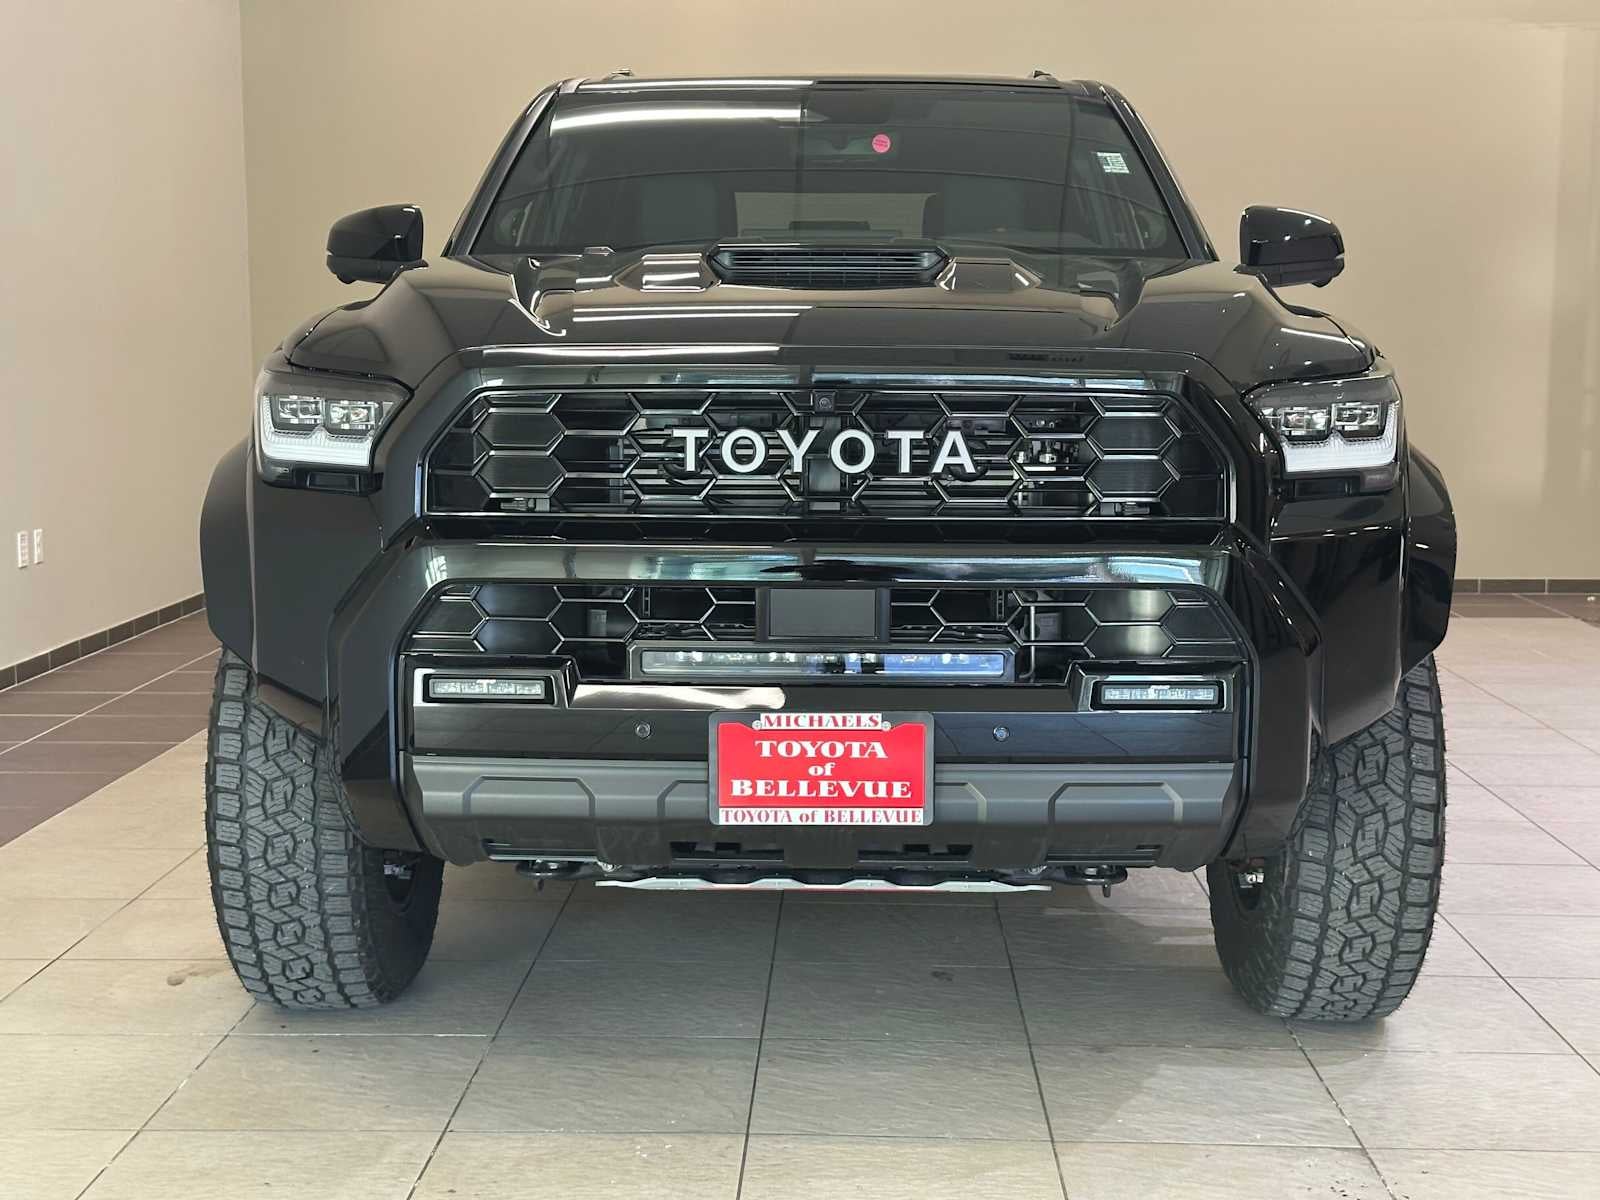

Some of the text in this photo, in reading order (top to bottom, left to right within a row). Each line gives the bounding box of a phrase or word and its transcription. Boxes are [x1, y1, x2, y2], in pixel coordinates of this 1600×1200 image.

[672, 429, 976, 474] TOYOTA
[763, 714, 880, 728] MICHAELS
[755, 740, 888, 758] TOYOTA
[808, 762, 836, 776] of
[731, 780, 912, 798] BELLEVUE
[721, 809, 922, 824] TOYOTA of BELLEVUE
